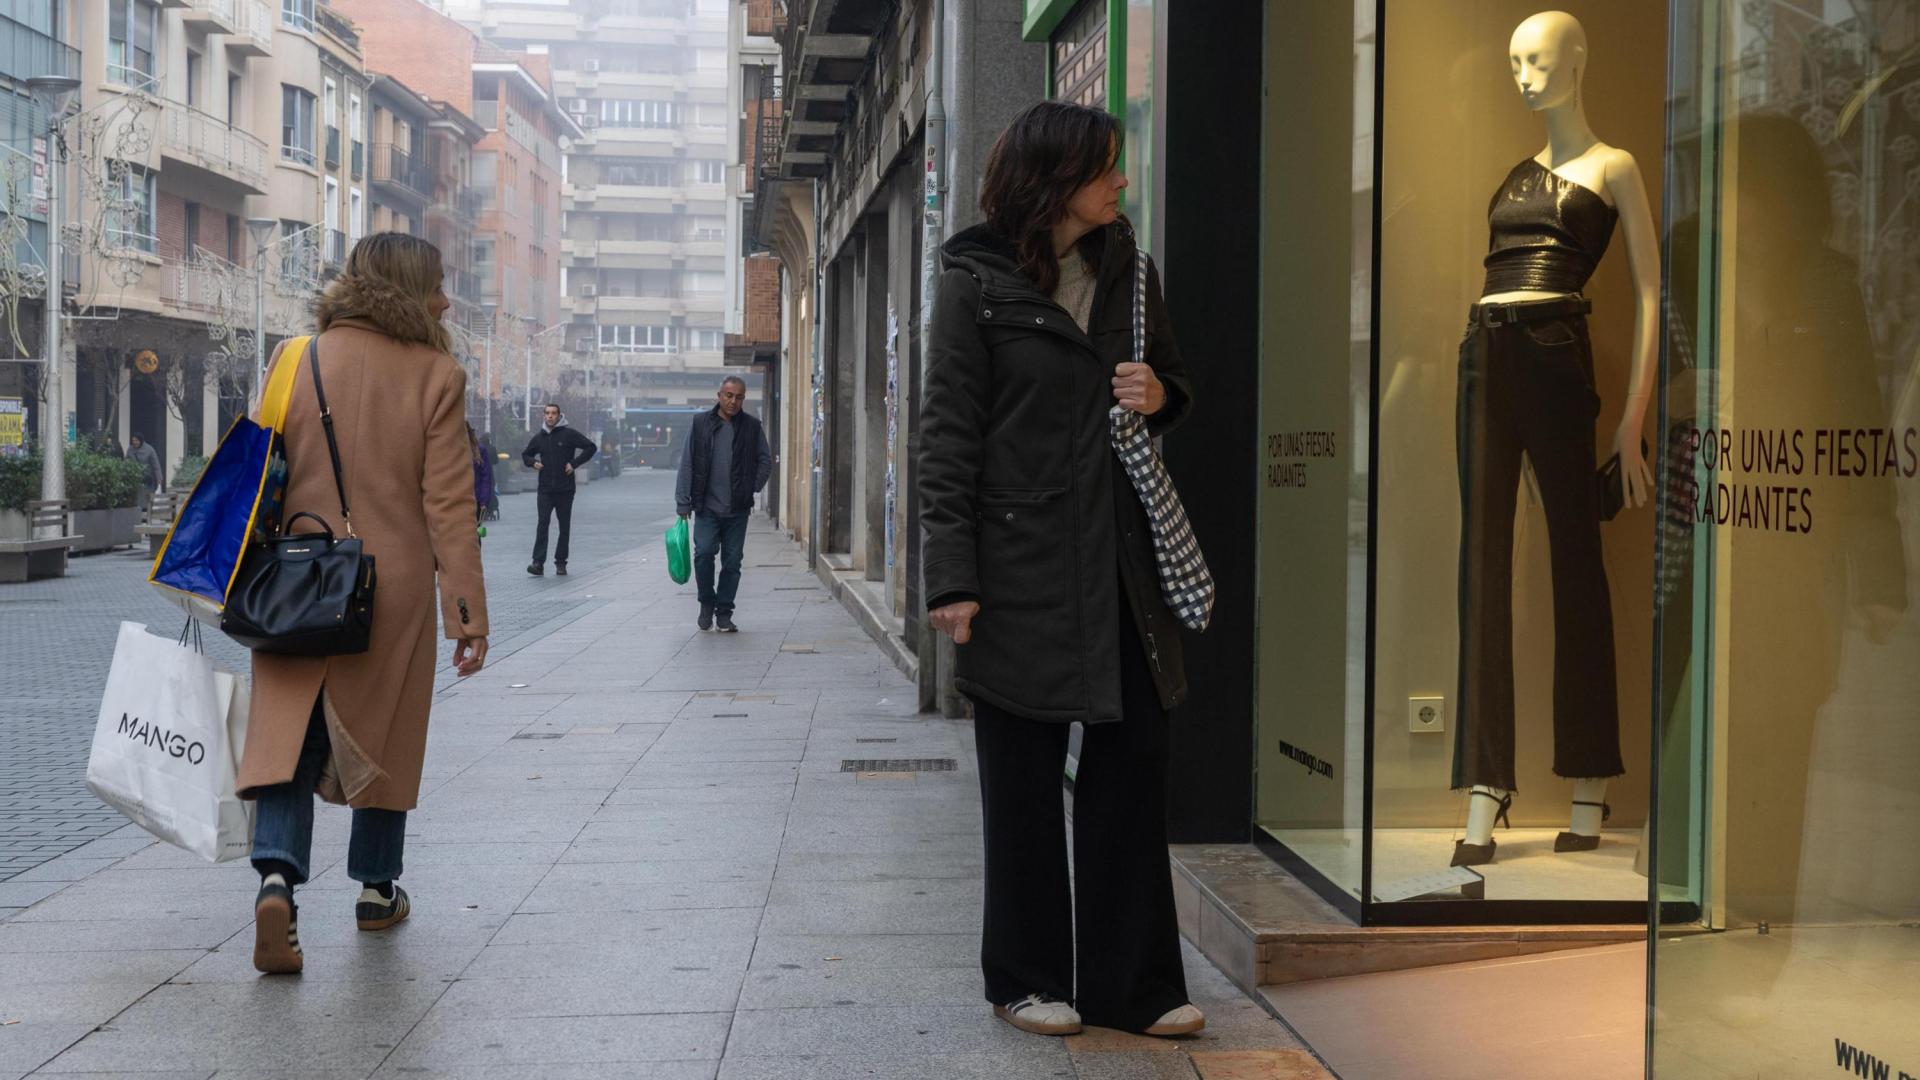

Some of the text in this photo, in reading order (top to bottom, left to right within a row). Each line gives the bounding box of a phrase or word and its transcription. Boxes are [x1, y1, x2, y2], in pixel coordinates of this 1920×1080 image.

[1268, 432, 1335, 457] POR UNAS FIESTAS
[1691, 428, 1917, 478] POR UNAS FIESTAS
[1268, 464, 1306, 488] RADIANTES
[1691, 481, 1812, 533] RADIANTES
[118, 712, 204, 765] MANGO
